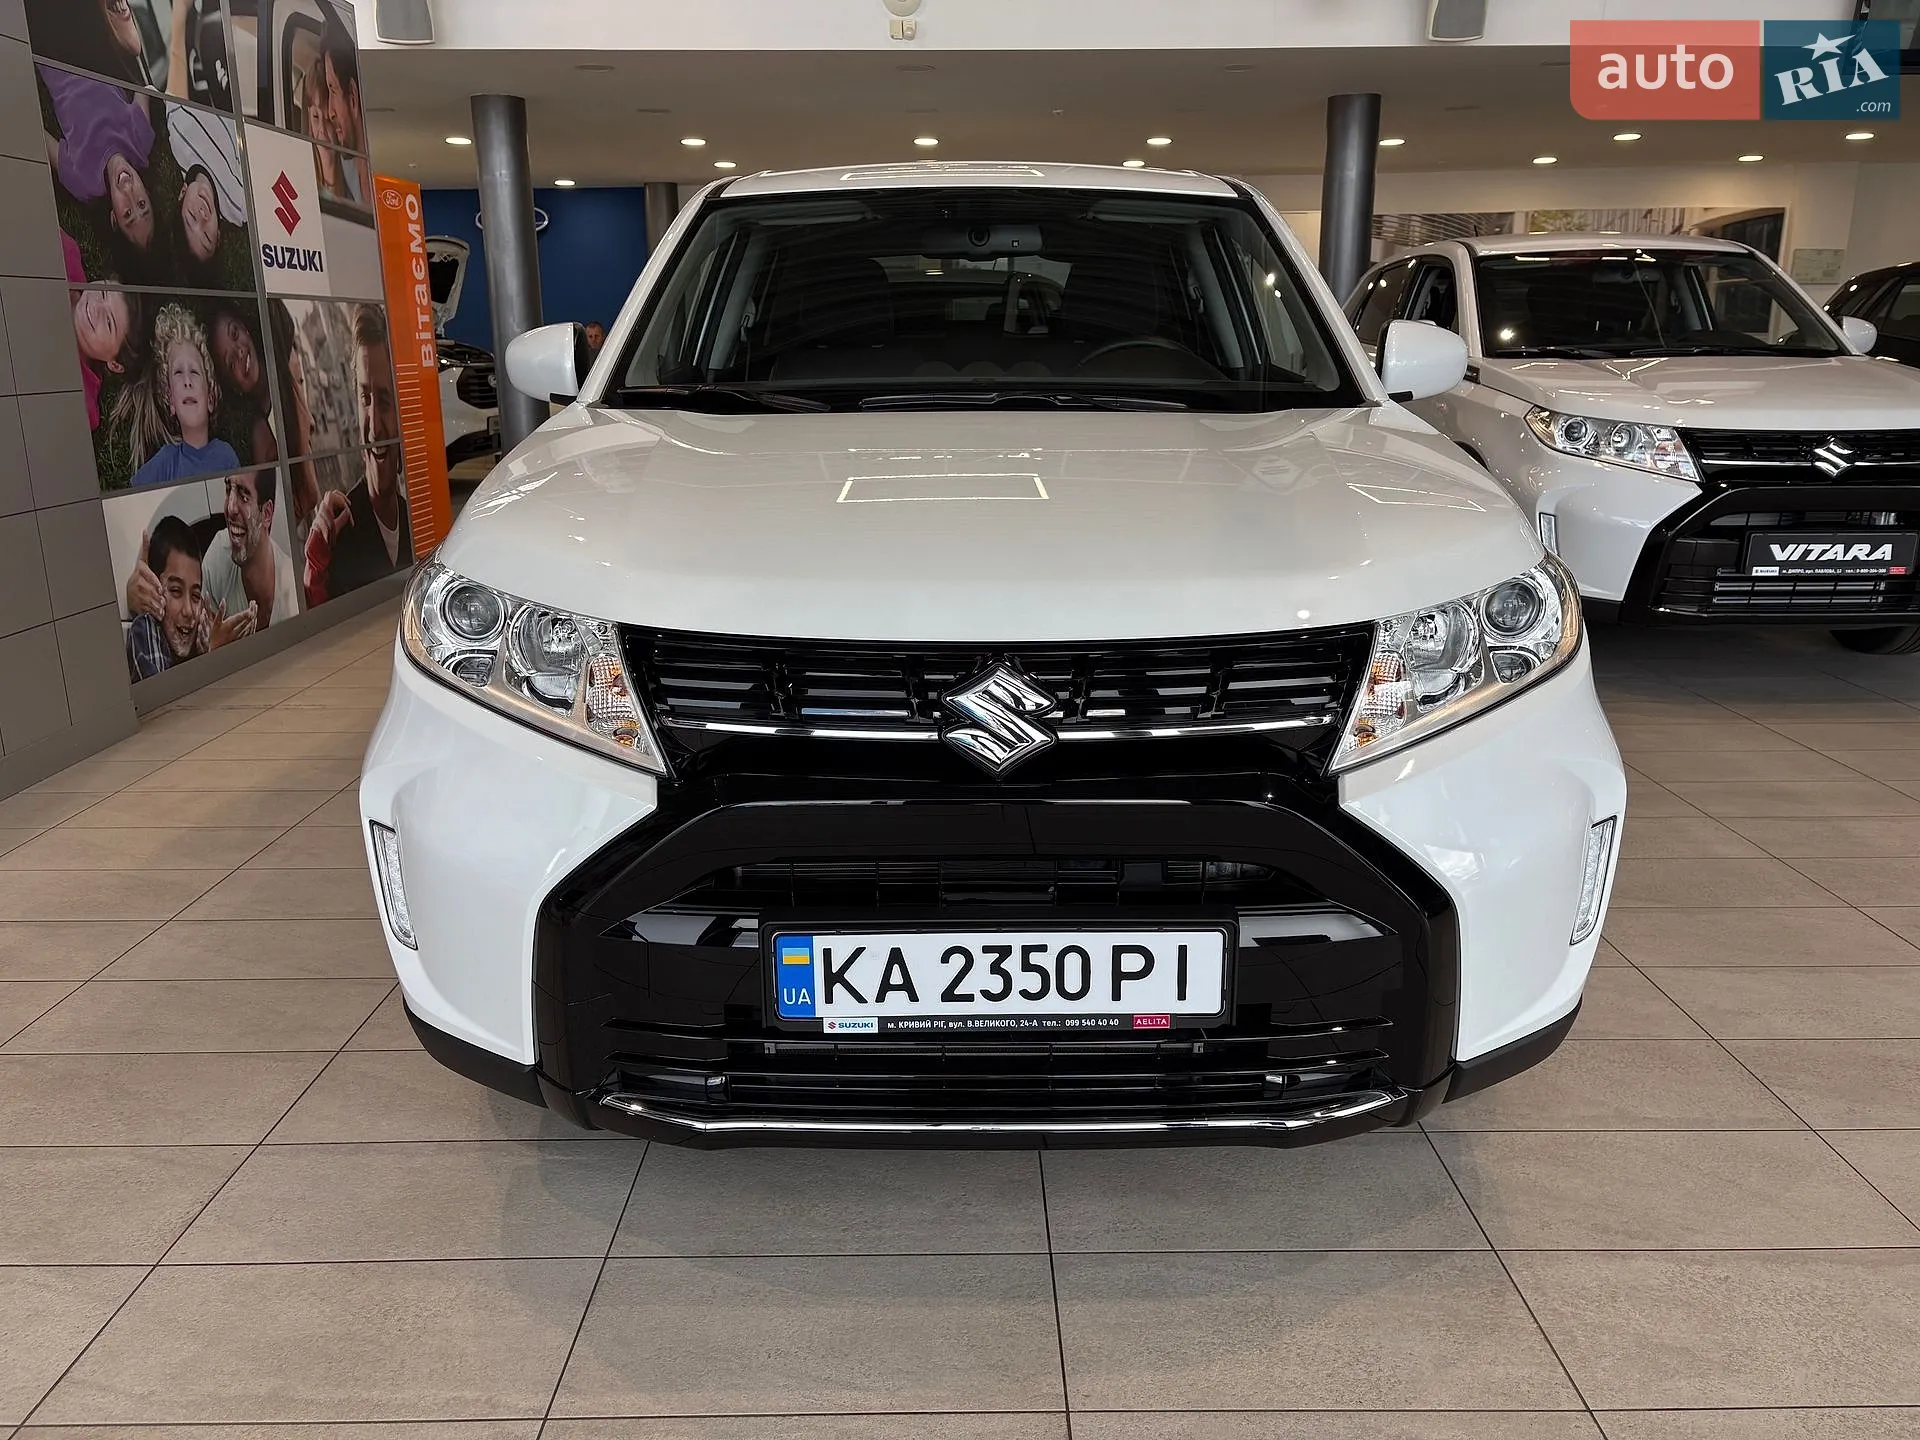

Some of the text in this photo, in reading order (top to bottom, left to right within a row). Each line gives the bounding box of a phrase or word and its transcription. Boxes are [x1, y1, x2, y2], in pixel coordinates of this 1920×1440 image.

[262, 243, 324, 273] SUZUKI
[1769, 544, 1893, 561] VITARA
[822, 947, 920, 1004] KA
[940, 944, 1091, 1003] 2350
[784, 988, 811, 1005] UA
[899, 1019, 931, 1029] КРИВИЙ
[933, 1020, 947, 1030] РІГ,
[948, 1021, 965, 1030] вул.
[967, 1019, 1018, 1028] В.ВЕЛИКОГО,
[1019, 1019, 1039, 1027] 24-А
[1065, 1019, 1080, 1027] 099
[1081, 1019, 1096, 1027] 540
[1097, 1018, 1107, 1026] 40
[1109, 1018, 1119, 1026] 40
